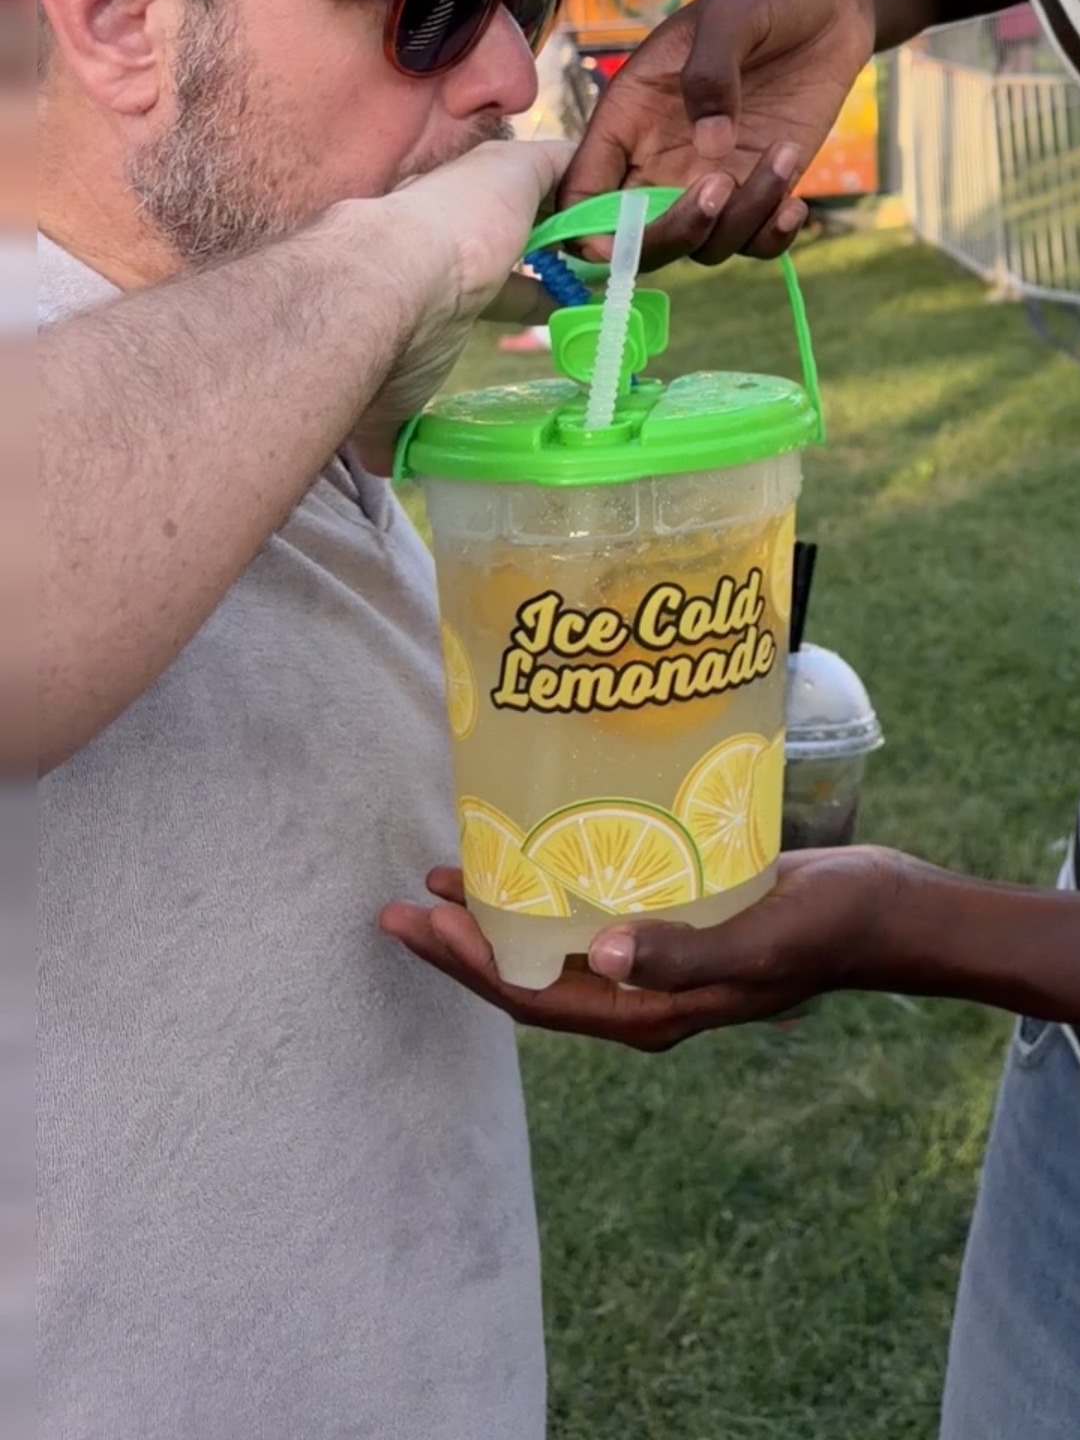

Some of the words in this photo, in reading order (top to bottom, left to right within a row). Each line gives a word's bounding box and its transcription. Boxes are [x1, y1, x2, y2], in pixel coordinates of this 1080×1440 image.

[510, 590, 630, 657] Ice
[633, 567, 764, 651] Cold
[490, 627, 777, 713] Lemonade
